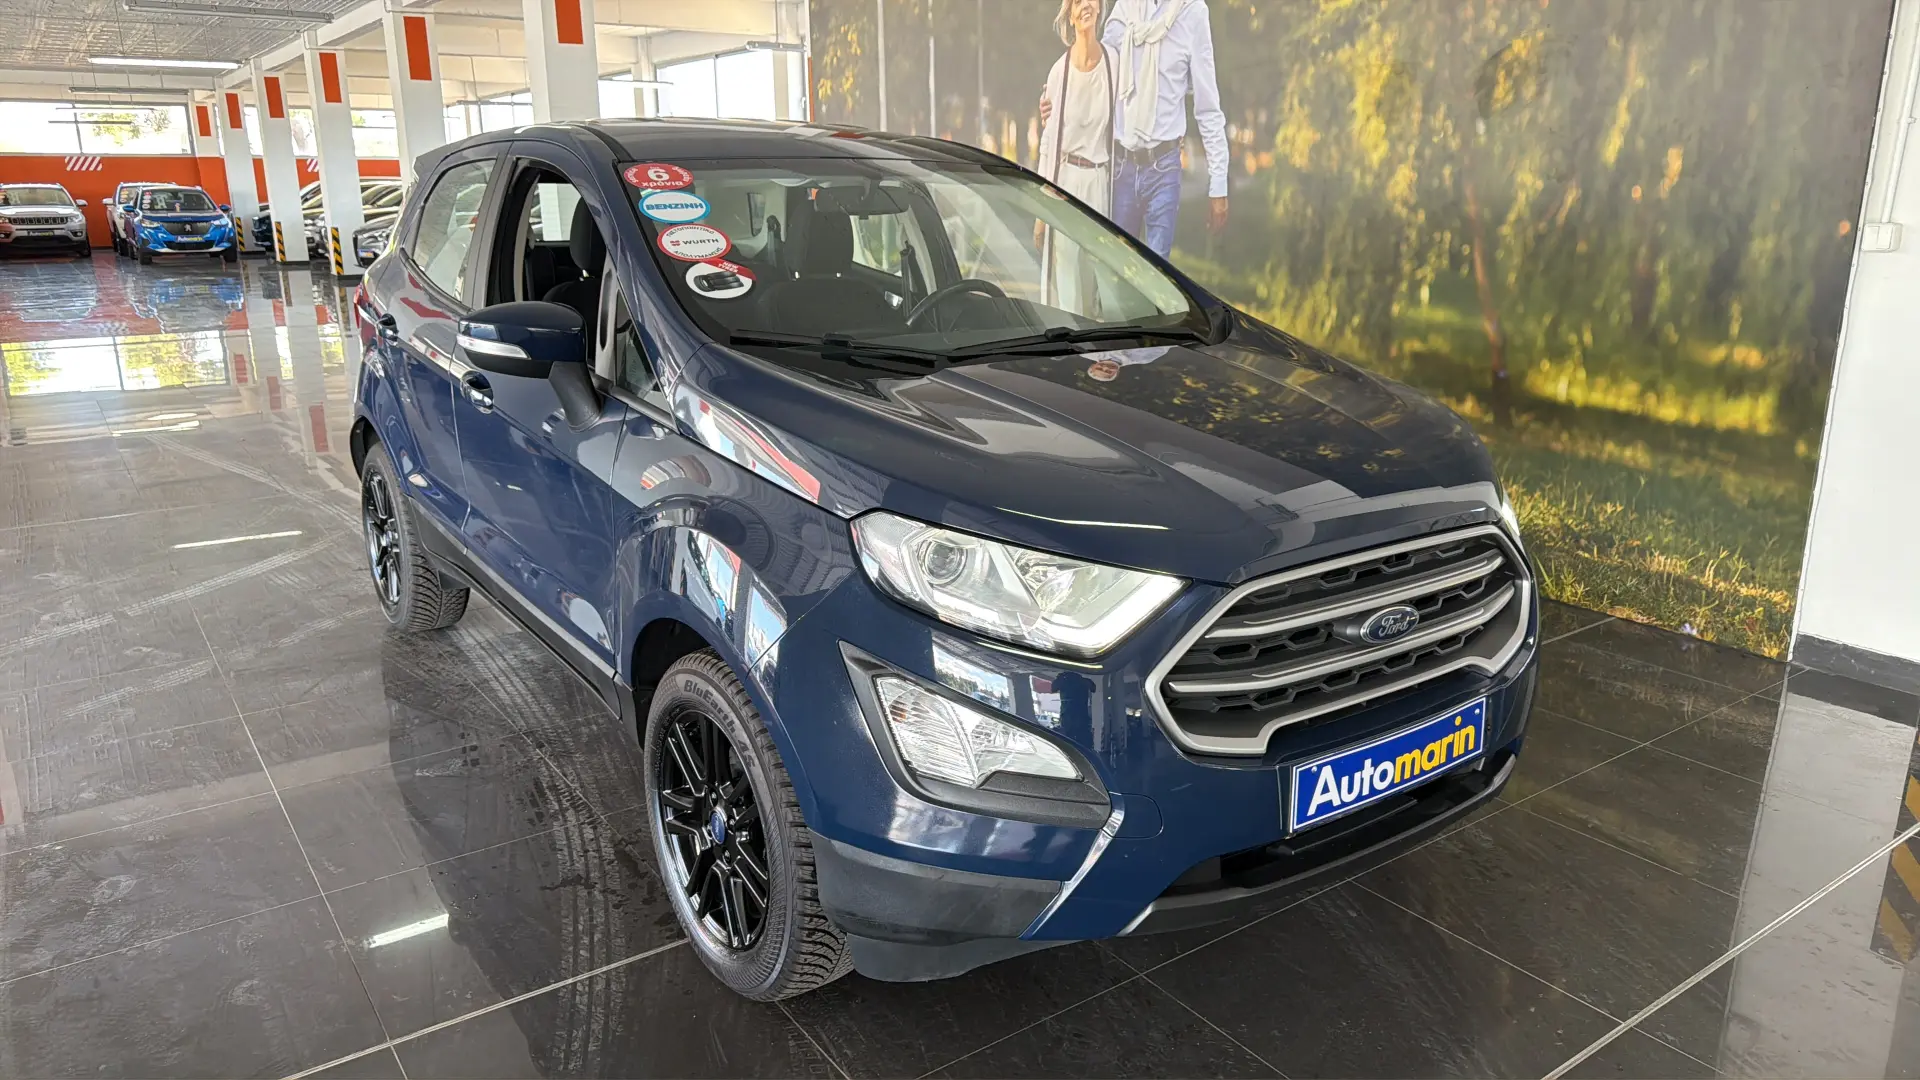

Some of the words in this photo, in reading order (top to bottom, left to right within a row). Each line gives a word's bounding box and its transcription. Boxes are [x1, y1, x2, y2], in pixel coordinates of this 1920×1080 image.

[647, 168, 670, 181] 6
[723, 261, 739, 269] NEW
[1378, 613, 1410, 638] Ford
[1306, 715, 1475, 817] Automarin
